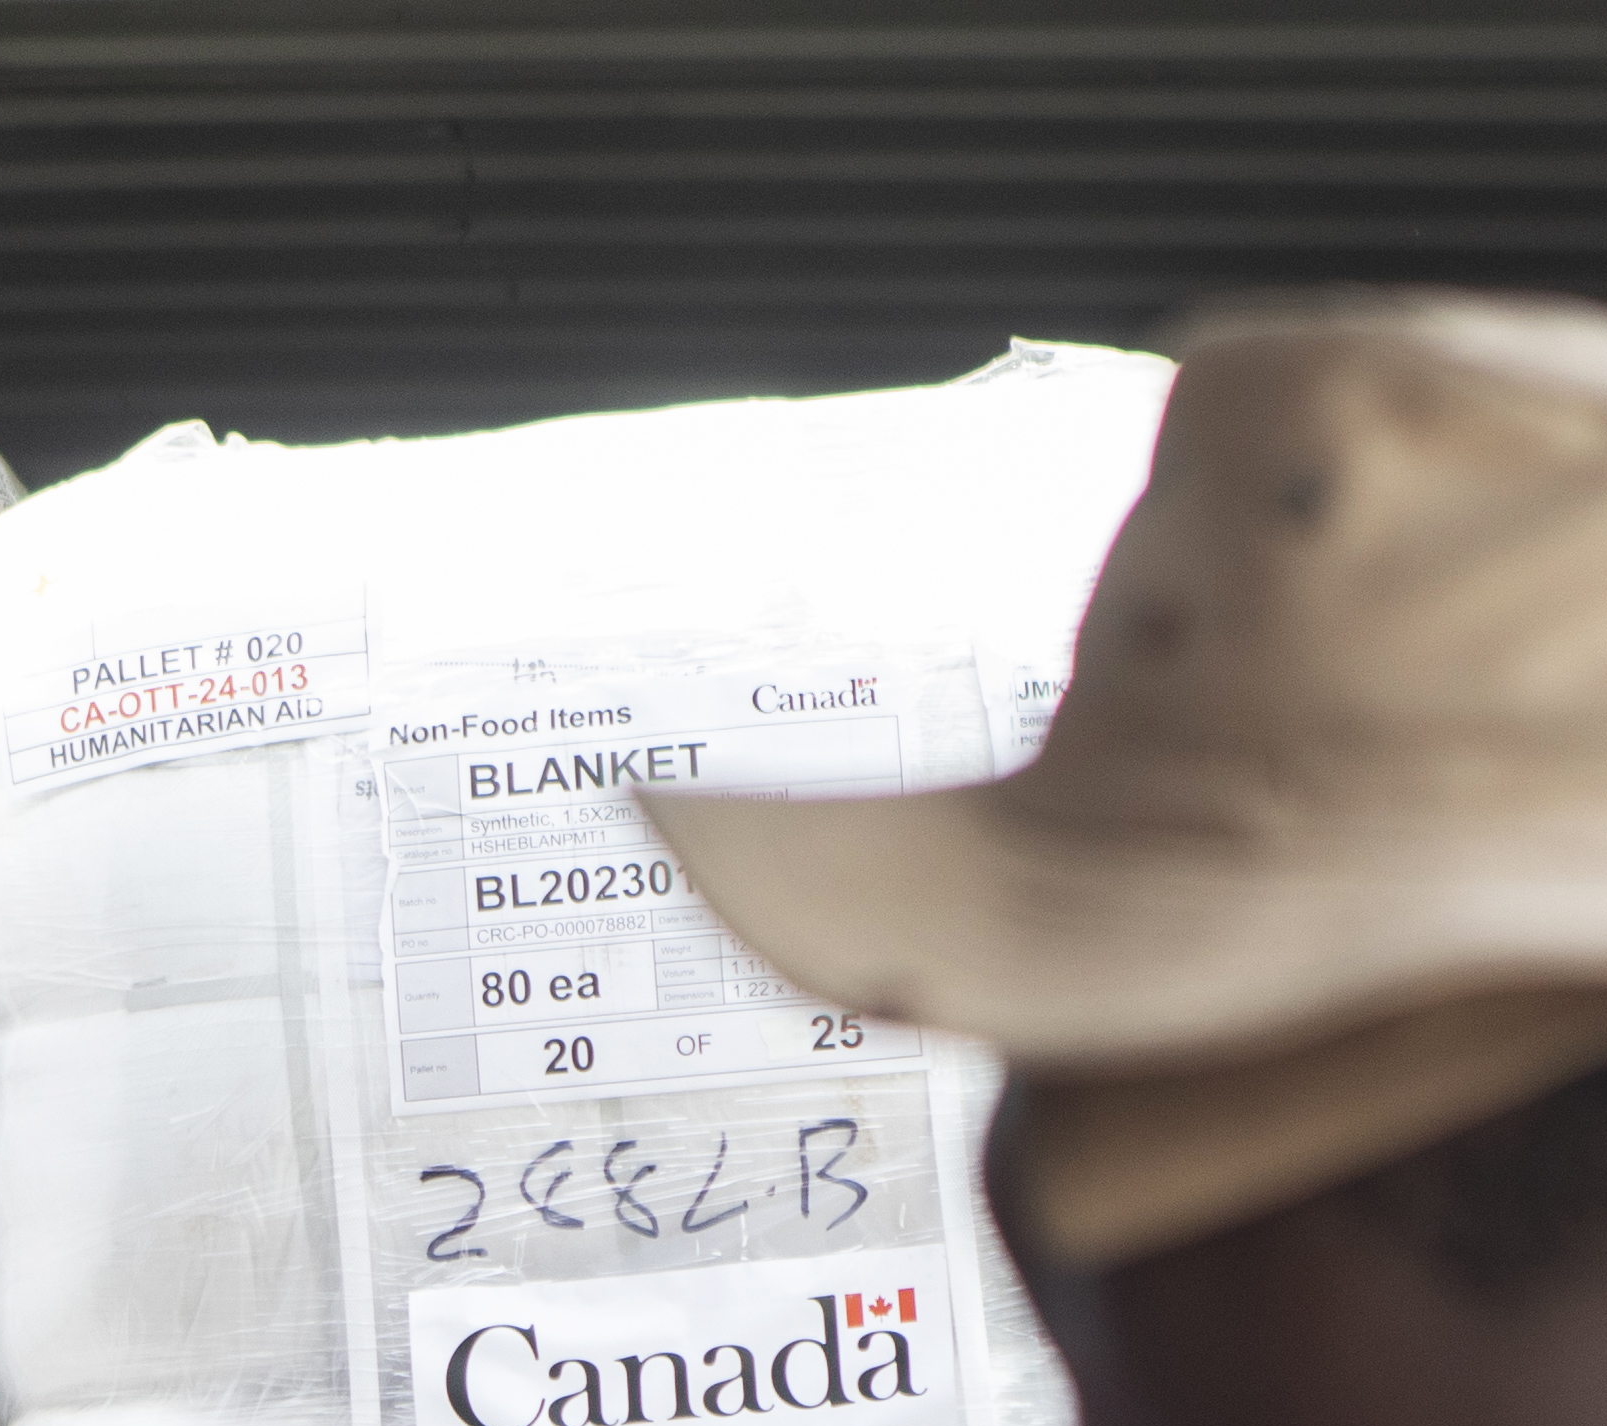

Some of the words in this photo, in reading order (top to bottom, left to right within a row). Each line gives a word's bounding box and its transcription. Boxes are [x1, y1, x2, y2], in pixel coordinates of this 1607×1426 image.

[72, 644, 204, 695] PALLET
[215, 639, 234, 666] #
[246, 631, 304, 664] 020
[59, 663, 310, 735] CA-OTT-24-013
[751, 677, 879, 716] Canada
[49, 704, 266, 770] HUMANITARIAN
[275, 696, 324, 722] AID
[389, 709, 538, 746] Non-Food
[549, 705, 633, 731] Items
[469, 742, 708, 801] BLANKET
[470, 809, 555, 837] synthetic,
[471, 830, 606, 855] HSHEBLANPMT1
[476, 914, 647, 945] CRC-PO-000078882
[731, 959, 766, 976] 1.11
[481, 969, 532, 1009] 80
[548, 970, 602, 1002] ea
[733, 981, 770, 998] 1.22
[543, 1035, 596, 1076] 20
[676, 1033, 713, 1057] OF
[810, 1013, 865, 1053] 25
